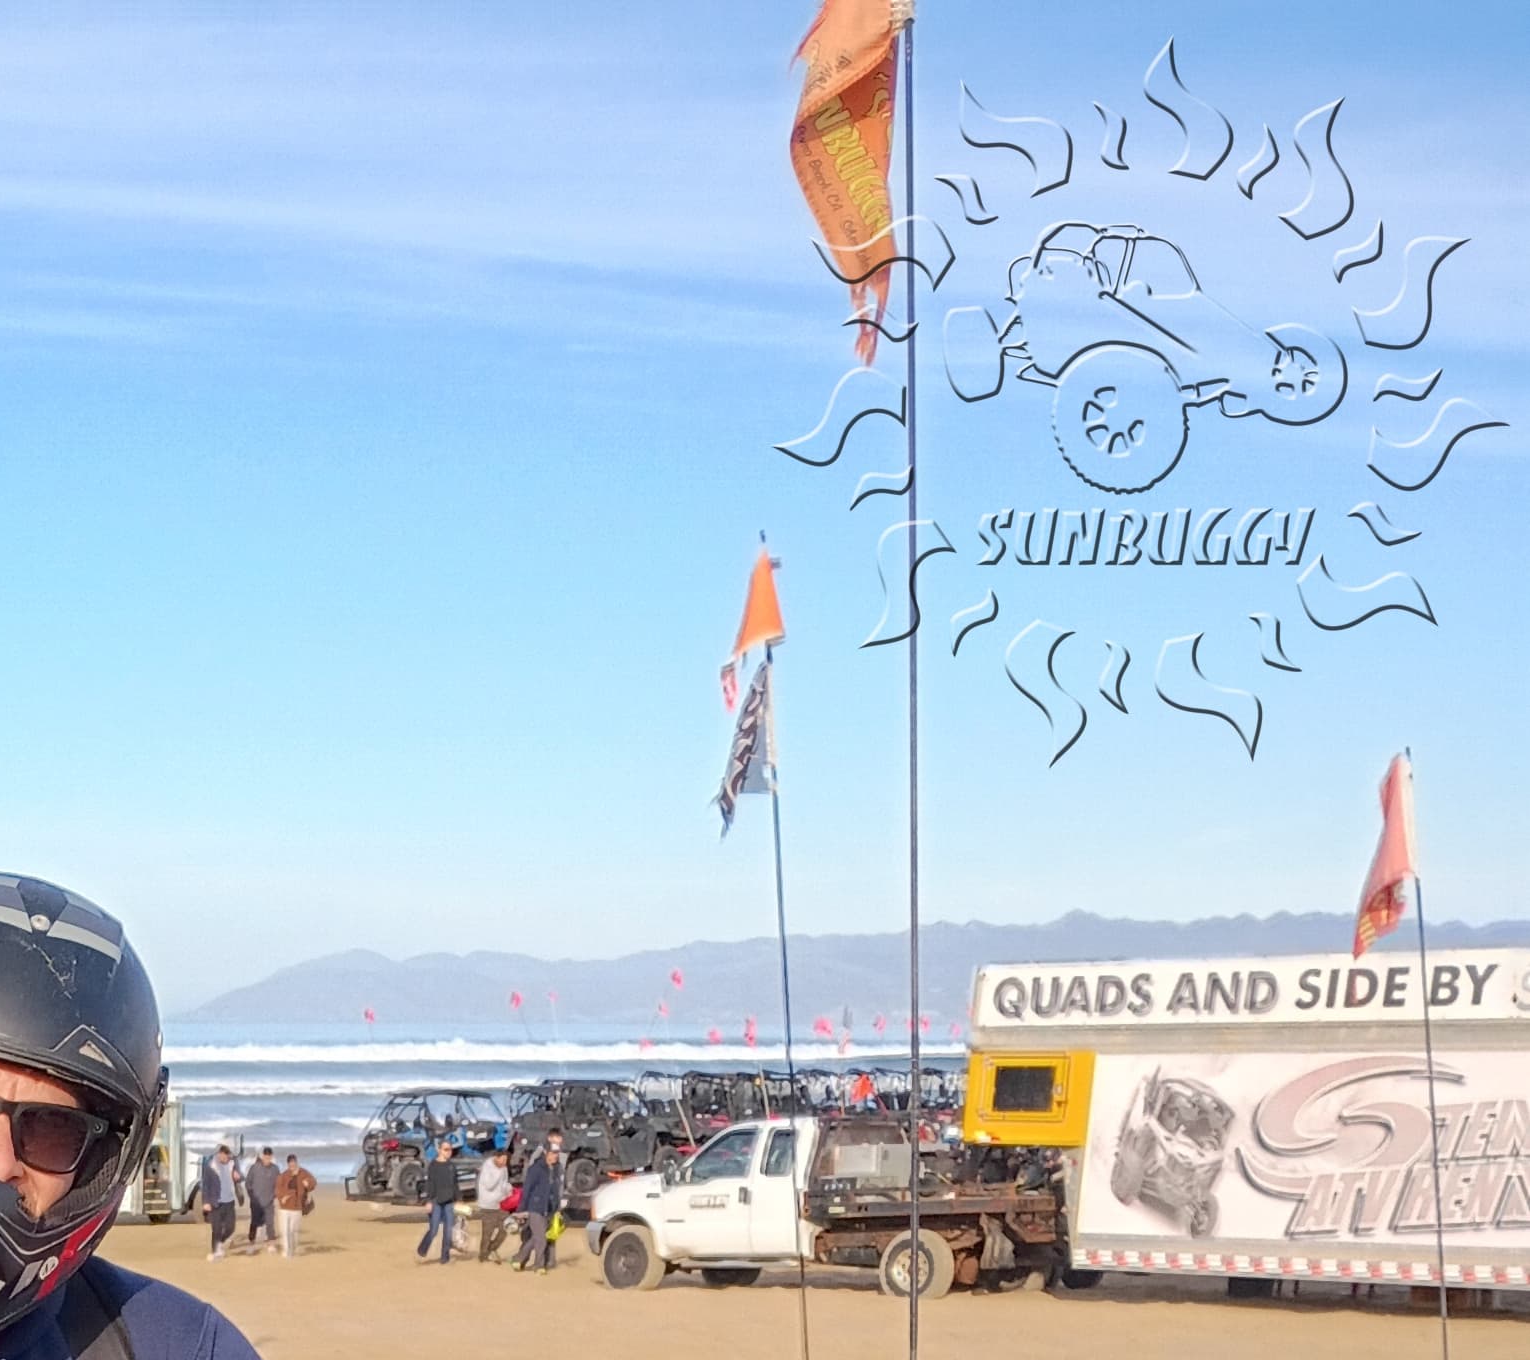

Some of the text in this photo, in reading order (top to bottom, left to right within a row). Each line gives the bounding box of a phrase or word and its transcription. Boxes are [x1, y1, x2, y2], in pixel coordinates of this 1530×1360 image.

[993, 972, 1155, 1021] QUADS
[1166, 970, 1281, 1016] AND
[1294, 966, 1411, 1010] SIDE
[1429, 964, 1499, 1007] BY
